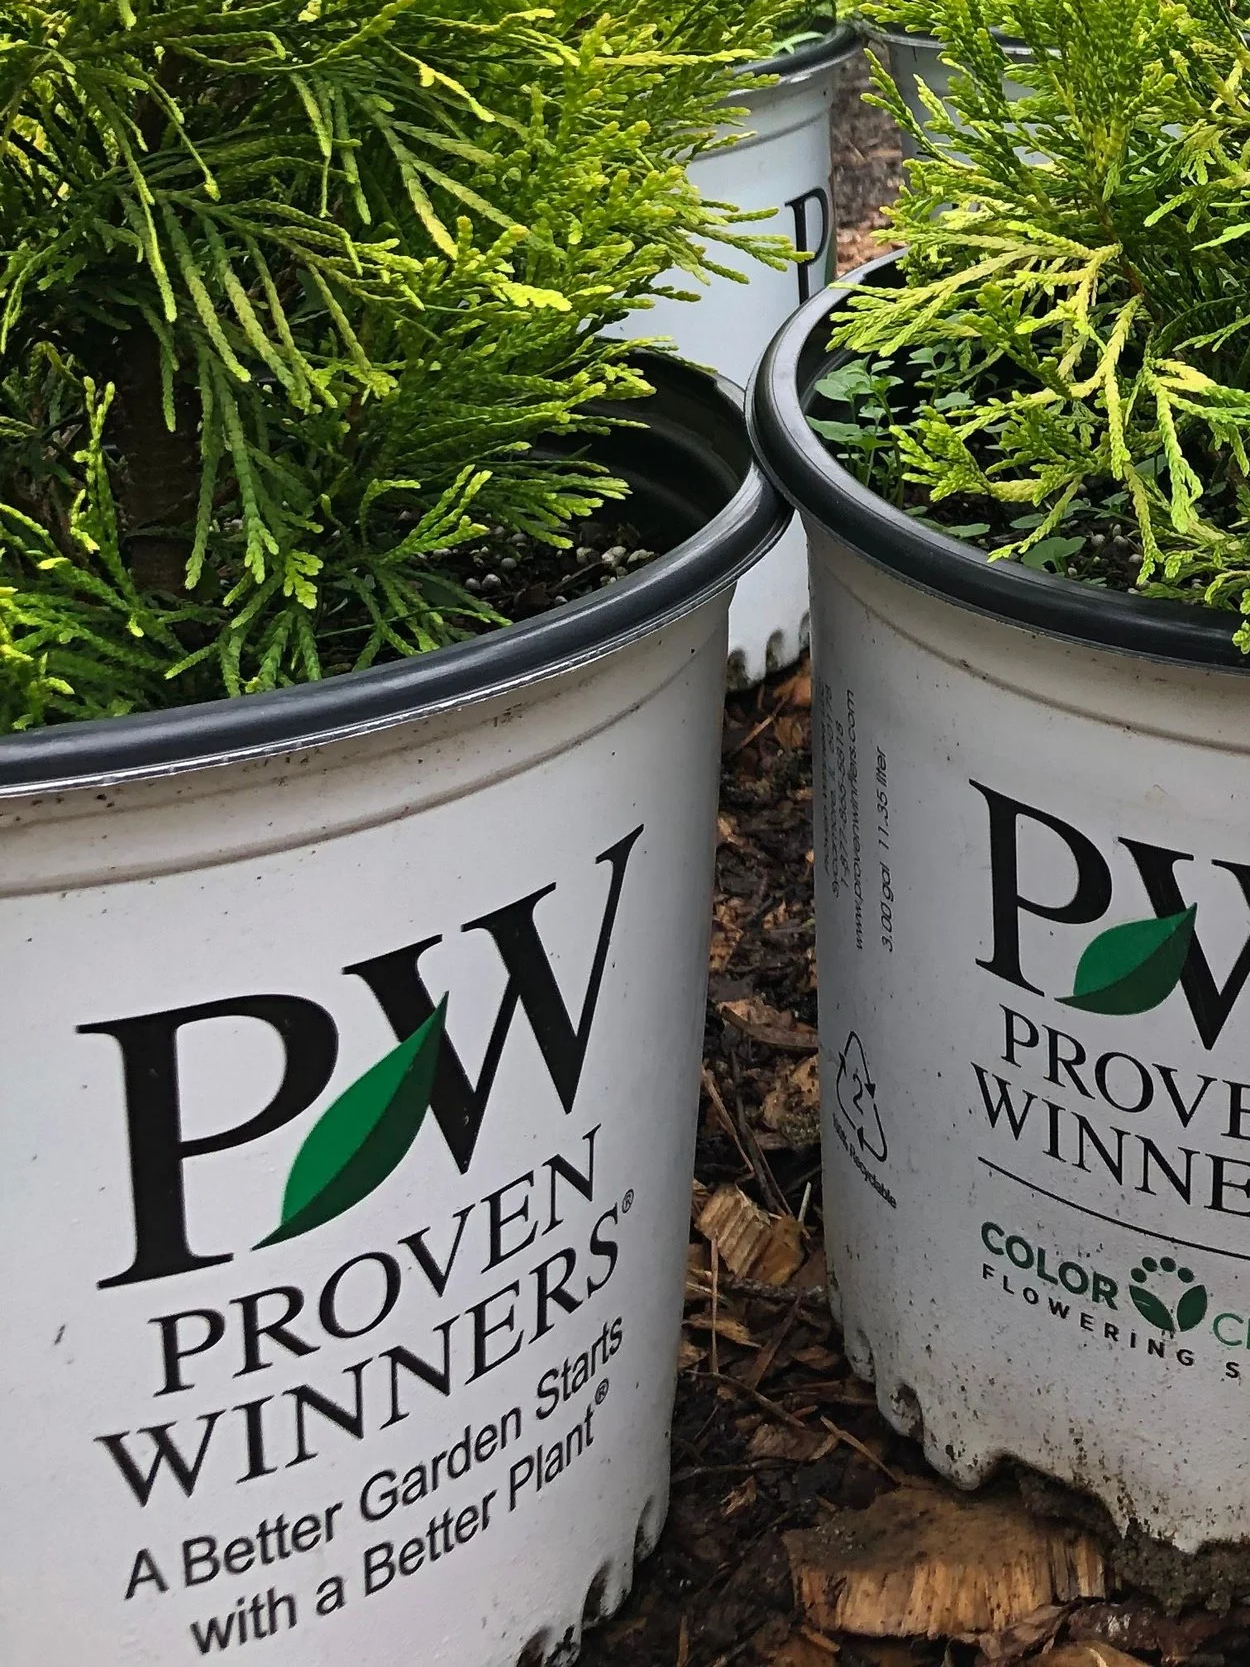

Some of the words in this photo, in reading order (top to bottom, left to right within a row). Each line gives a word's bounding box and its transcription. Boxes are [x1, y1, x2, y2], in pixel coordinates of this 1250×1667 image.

[844, 689, 864, 950] www.provenwinners.com
[874, 745, 887, 787] liter
[879, 865, 895, 902] gal
[880, 902, 893, 952] 3.00
[75, 824, 647, 1290] PW
[148, 1124, 603, 1397] PROVEN
[980, 1222, 1118, 1311] COLOR
[982, 1262, 1195, 1367] FLOWERING
[124, 1549, 168, 1601] A
[182, 1502, 343, 1587] Better
[360, 1407, 522, 1521] Garden
[535, 1315, 624, 1420] Starts
[190, 1586, 297, 1656] with
[315, 1575, 346, 1617] a
[364, 1488, 496, 1596] Better
